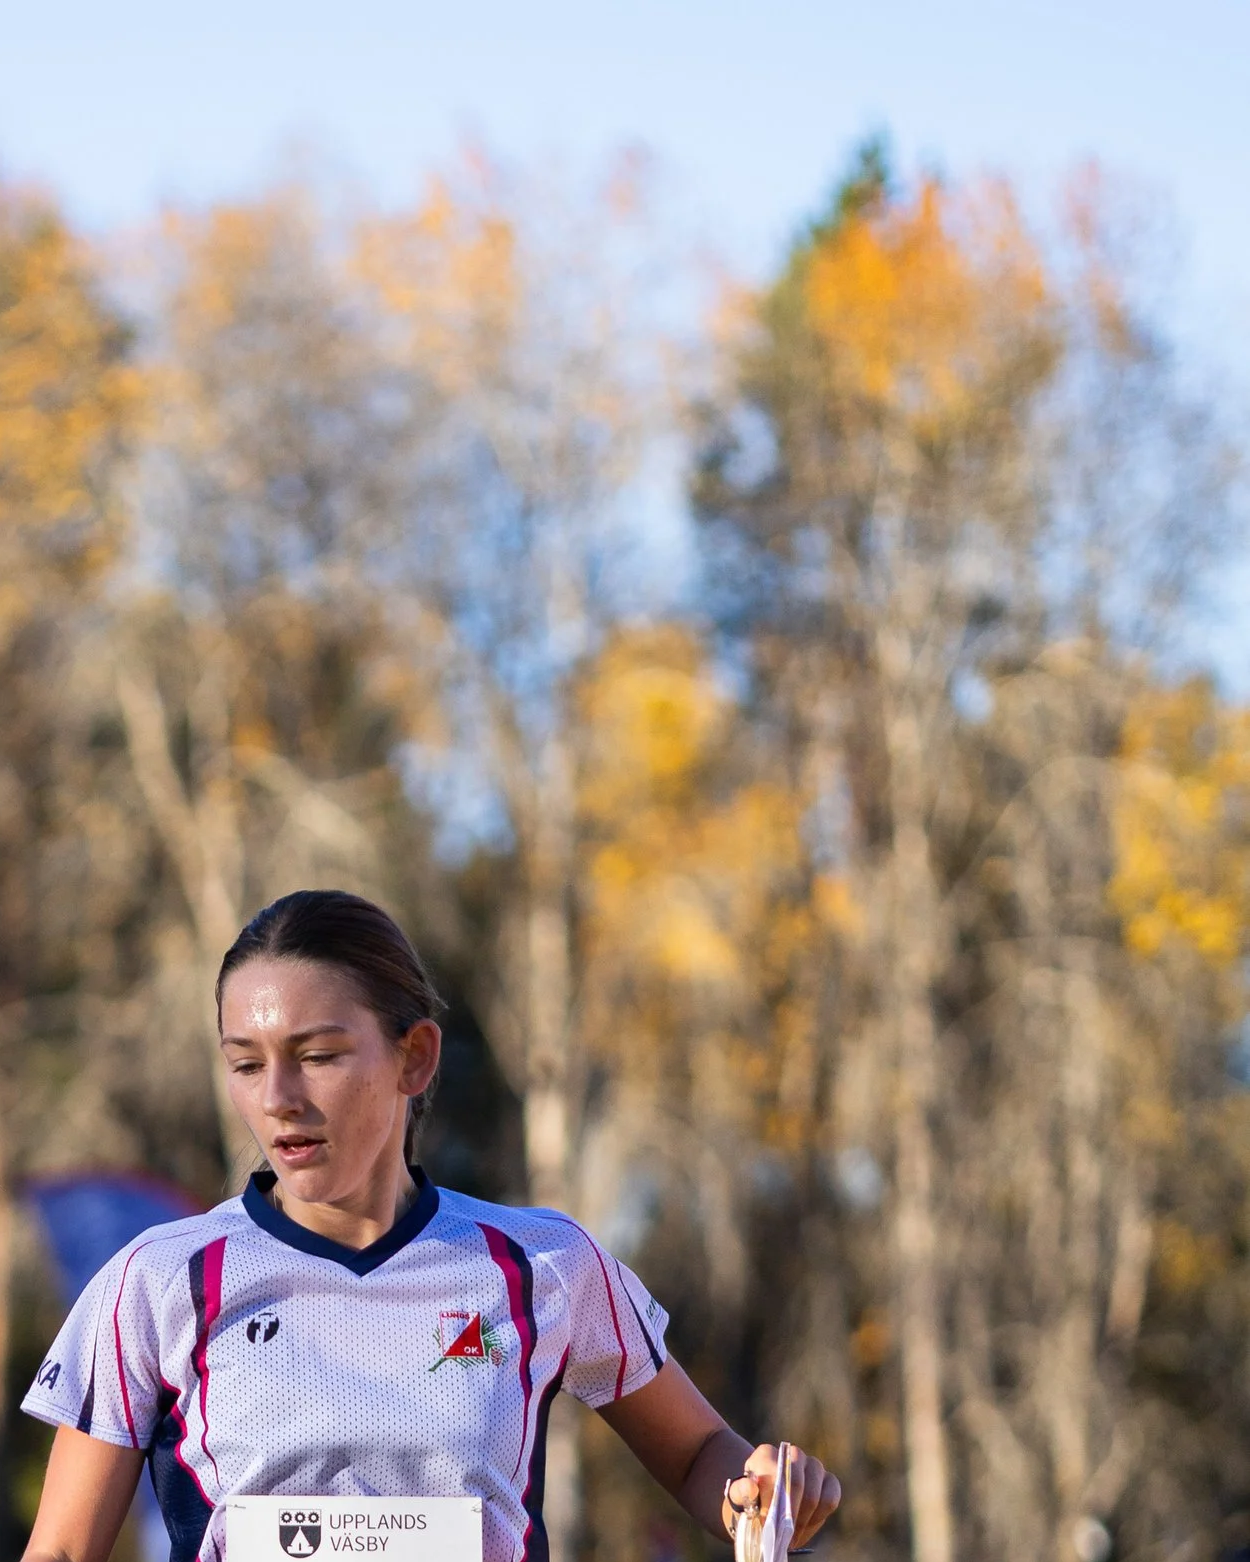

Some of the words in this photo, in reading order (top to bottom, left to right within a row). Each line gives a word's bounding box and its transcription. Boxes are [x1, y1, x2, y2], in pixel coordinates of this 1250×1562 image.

[441, 1312, 470, 1320] LUNDS
[463, 1345, 479, 1354] OK
[329, 1513, 427, 1531] UPPLANDS
[330, 1532, 389, 1552] VÄSBY
